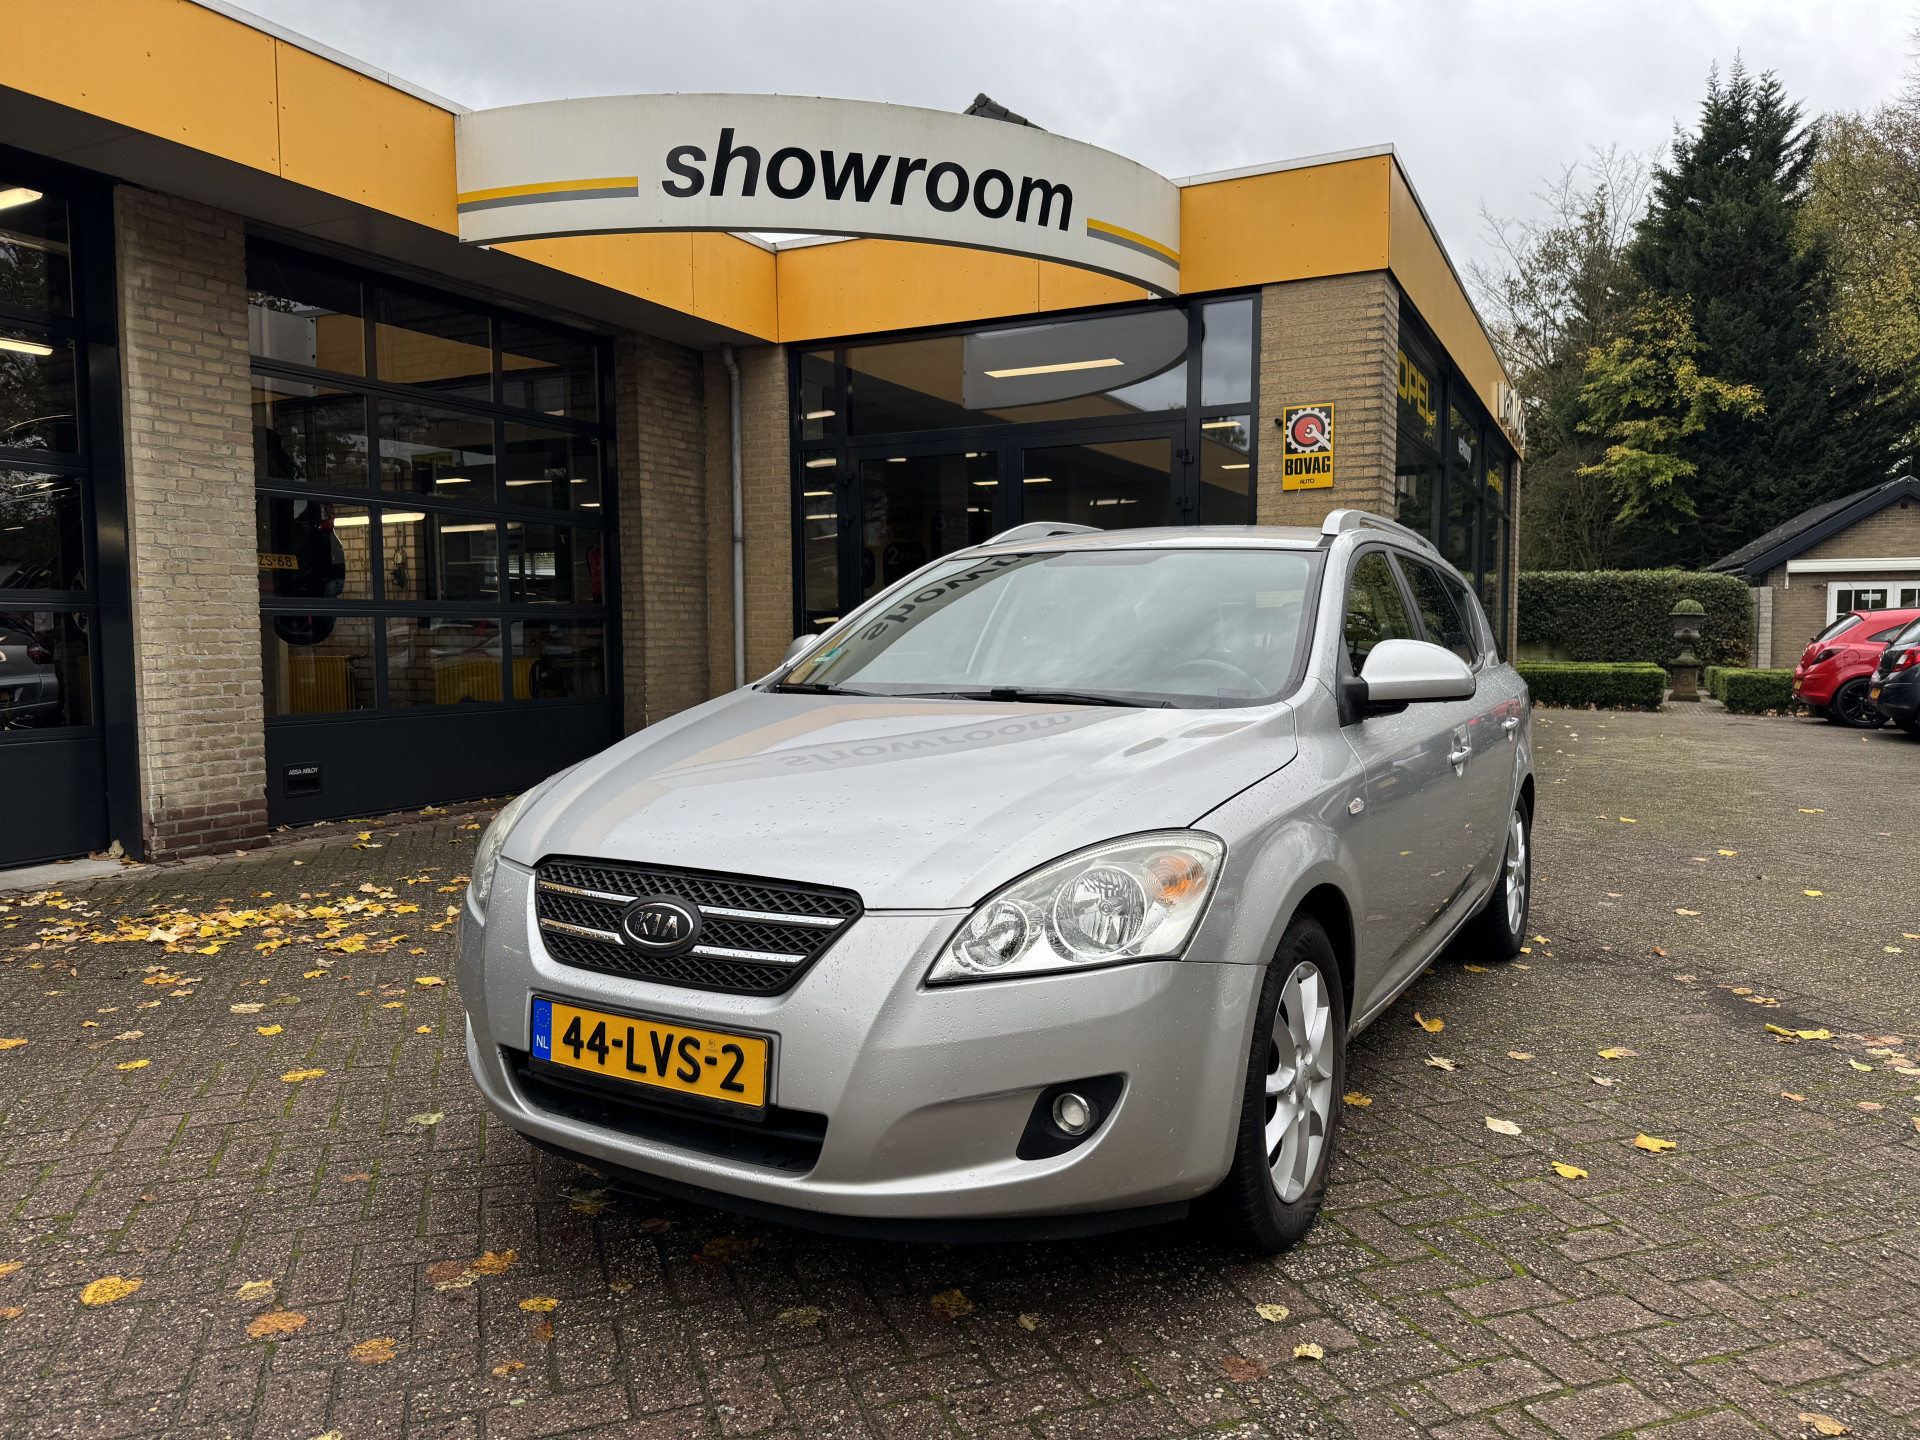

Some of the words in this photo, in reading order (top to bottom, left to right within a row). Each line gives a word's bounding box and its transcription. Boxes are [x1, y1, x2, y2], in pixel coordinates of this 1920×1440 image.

[661, 127, 1074, 231] showroom
[1398, 349, 1434, 424] OPEL
[1285, 456, 1330, 476] BOVAG
[289, 768, 303, 776] ASSA
[303, 767, 318, 775] ABLOY
[633, 911, 679, 939] KIA
[536, 1034, 549, 1050] NL
[562, 1016, 744, 1093] 44-LVS-2
